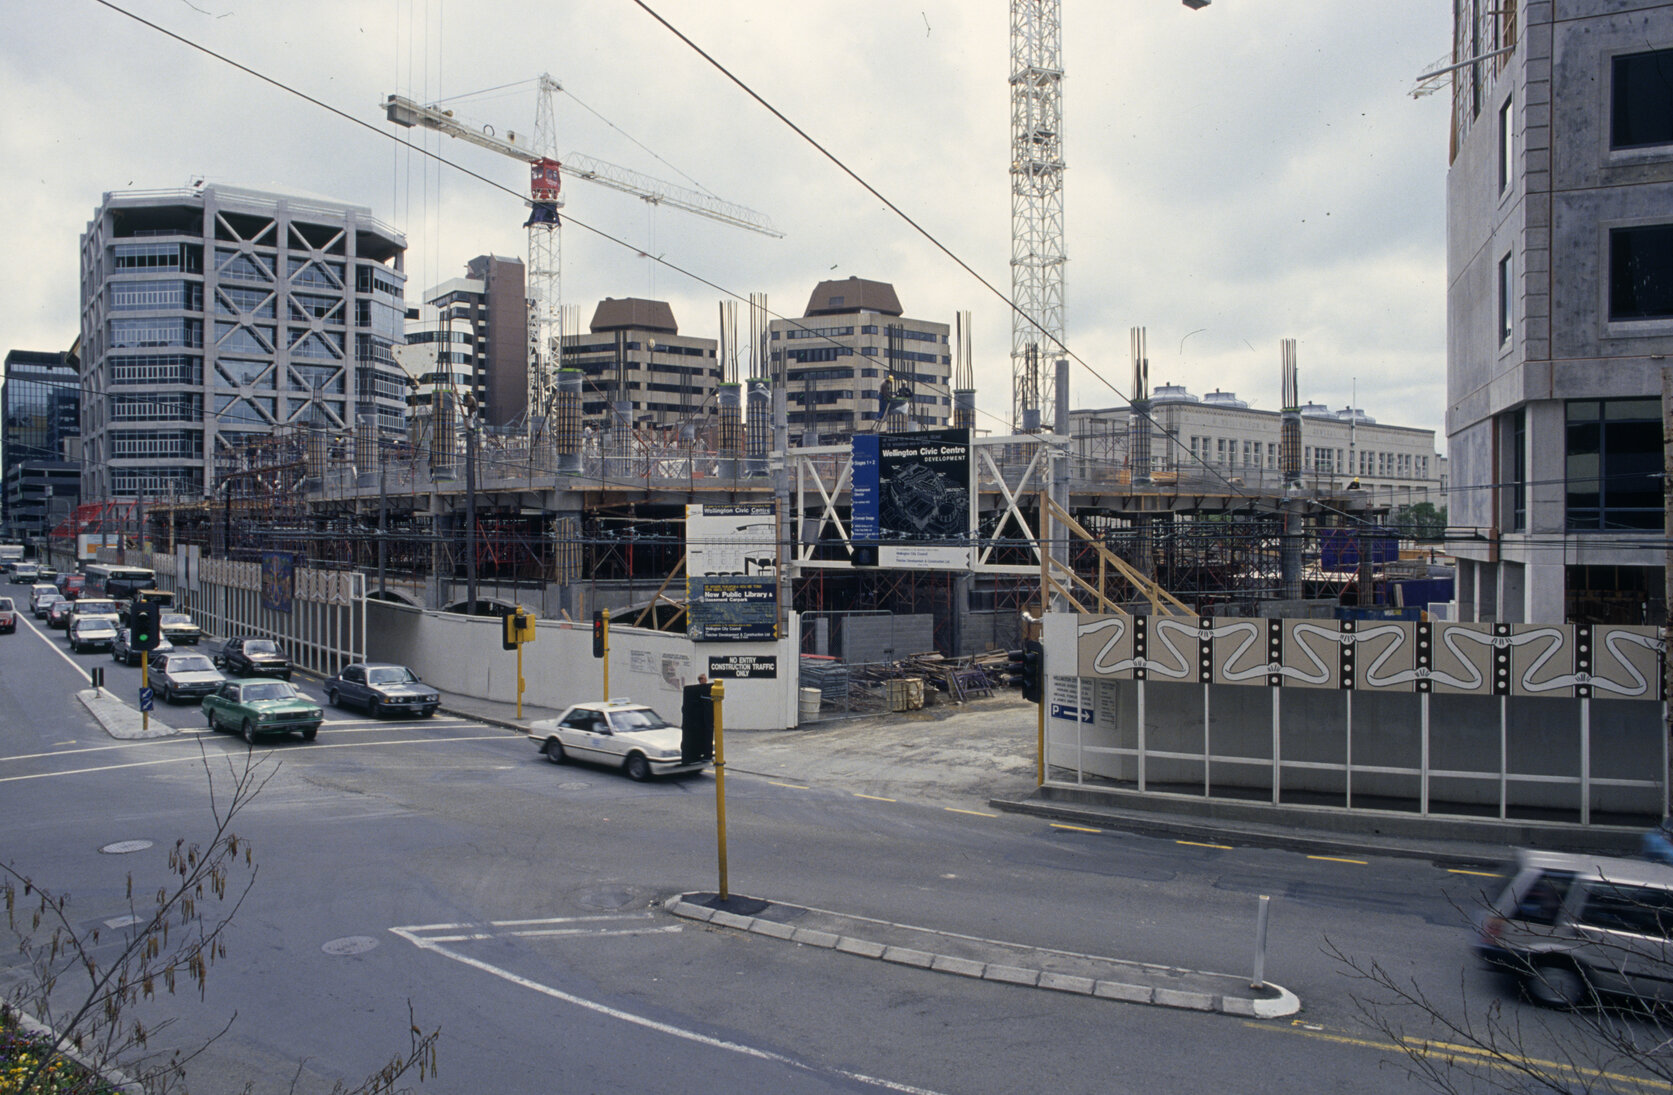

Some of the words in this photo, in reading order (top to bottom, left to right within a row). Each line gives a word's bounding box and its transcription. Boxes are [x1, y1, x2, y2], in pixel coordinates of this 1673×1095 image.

[882, 448, 918, 458] Wellington
[919, 447, 938, 455] Civic
[940, 446, 966, 454] Centre
[1052, 705, 1060, 715] P
